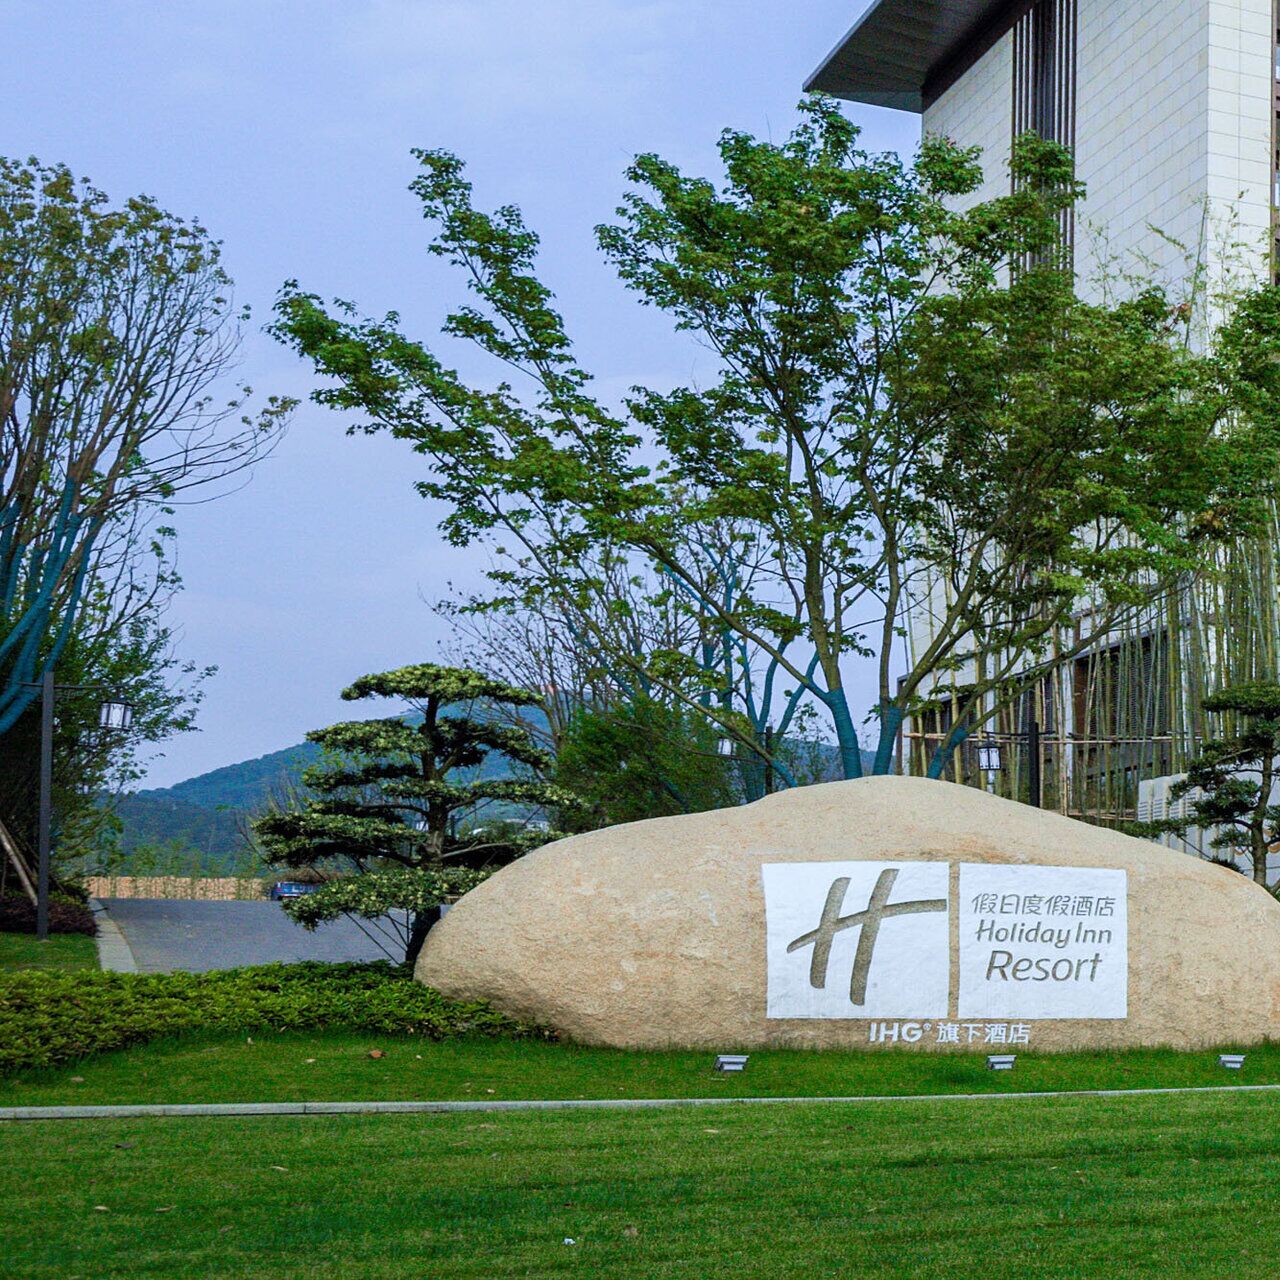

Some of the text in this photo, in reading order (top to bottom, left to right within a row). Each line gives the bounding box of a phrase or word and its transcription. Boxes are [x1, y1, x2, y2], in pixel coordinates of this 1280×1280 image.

[971, 893, 1116, 917] 假日度假酒店
[975, 919, 1112, 949] Holiday Inn
[985, 950, 1103, 982] Resort
[936, 1022, 1032, 1044] 旗下酒店
